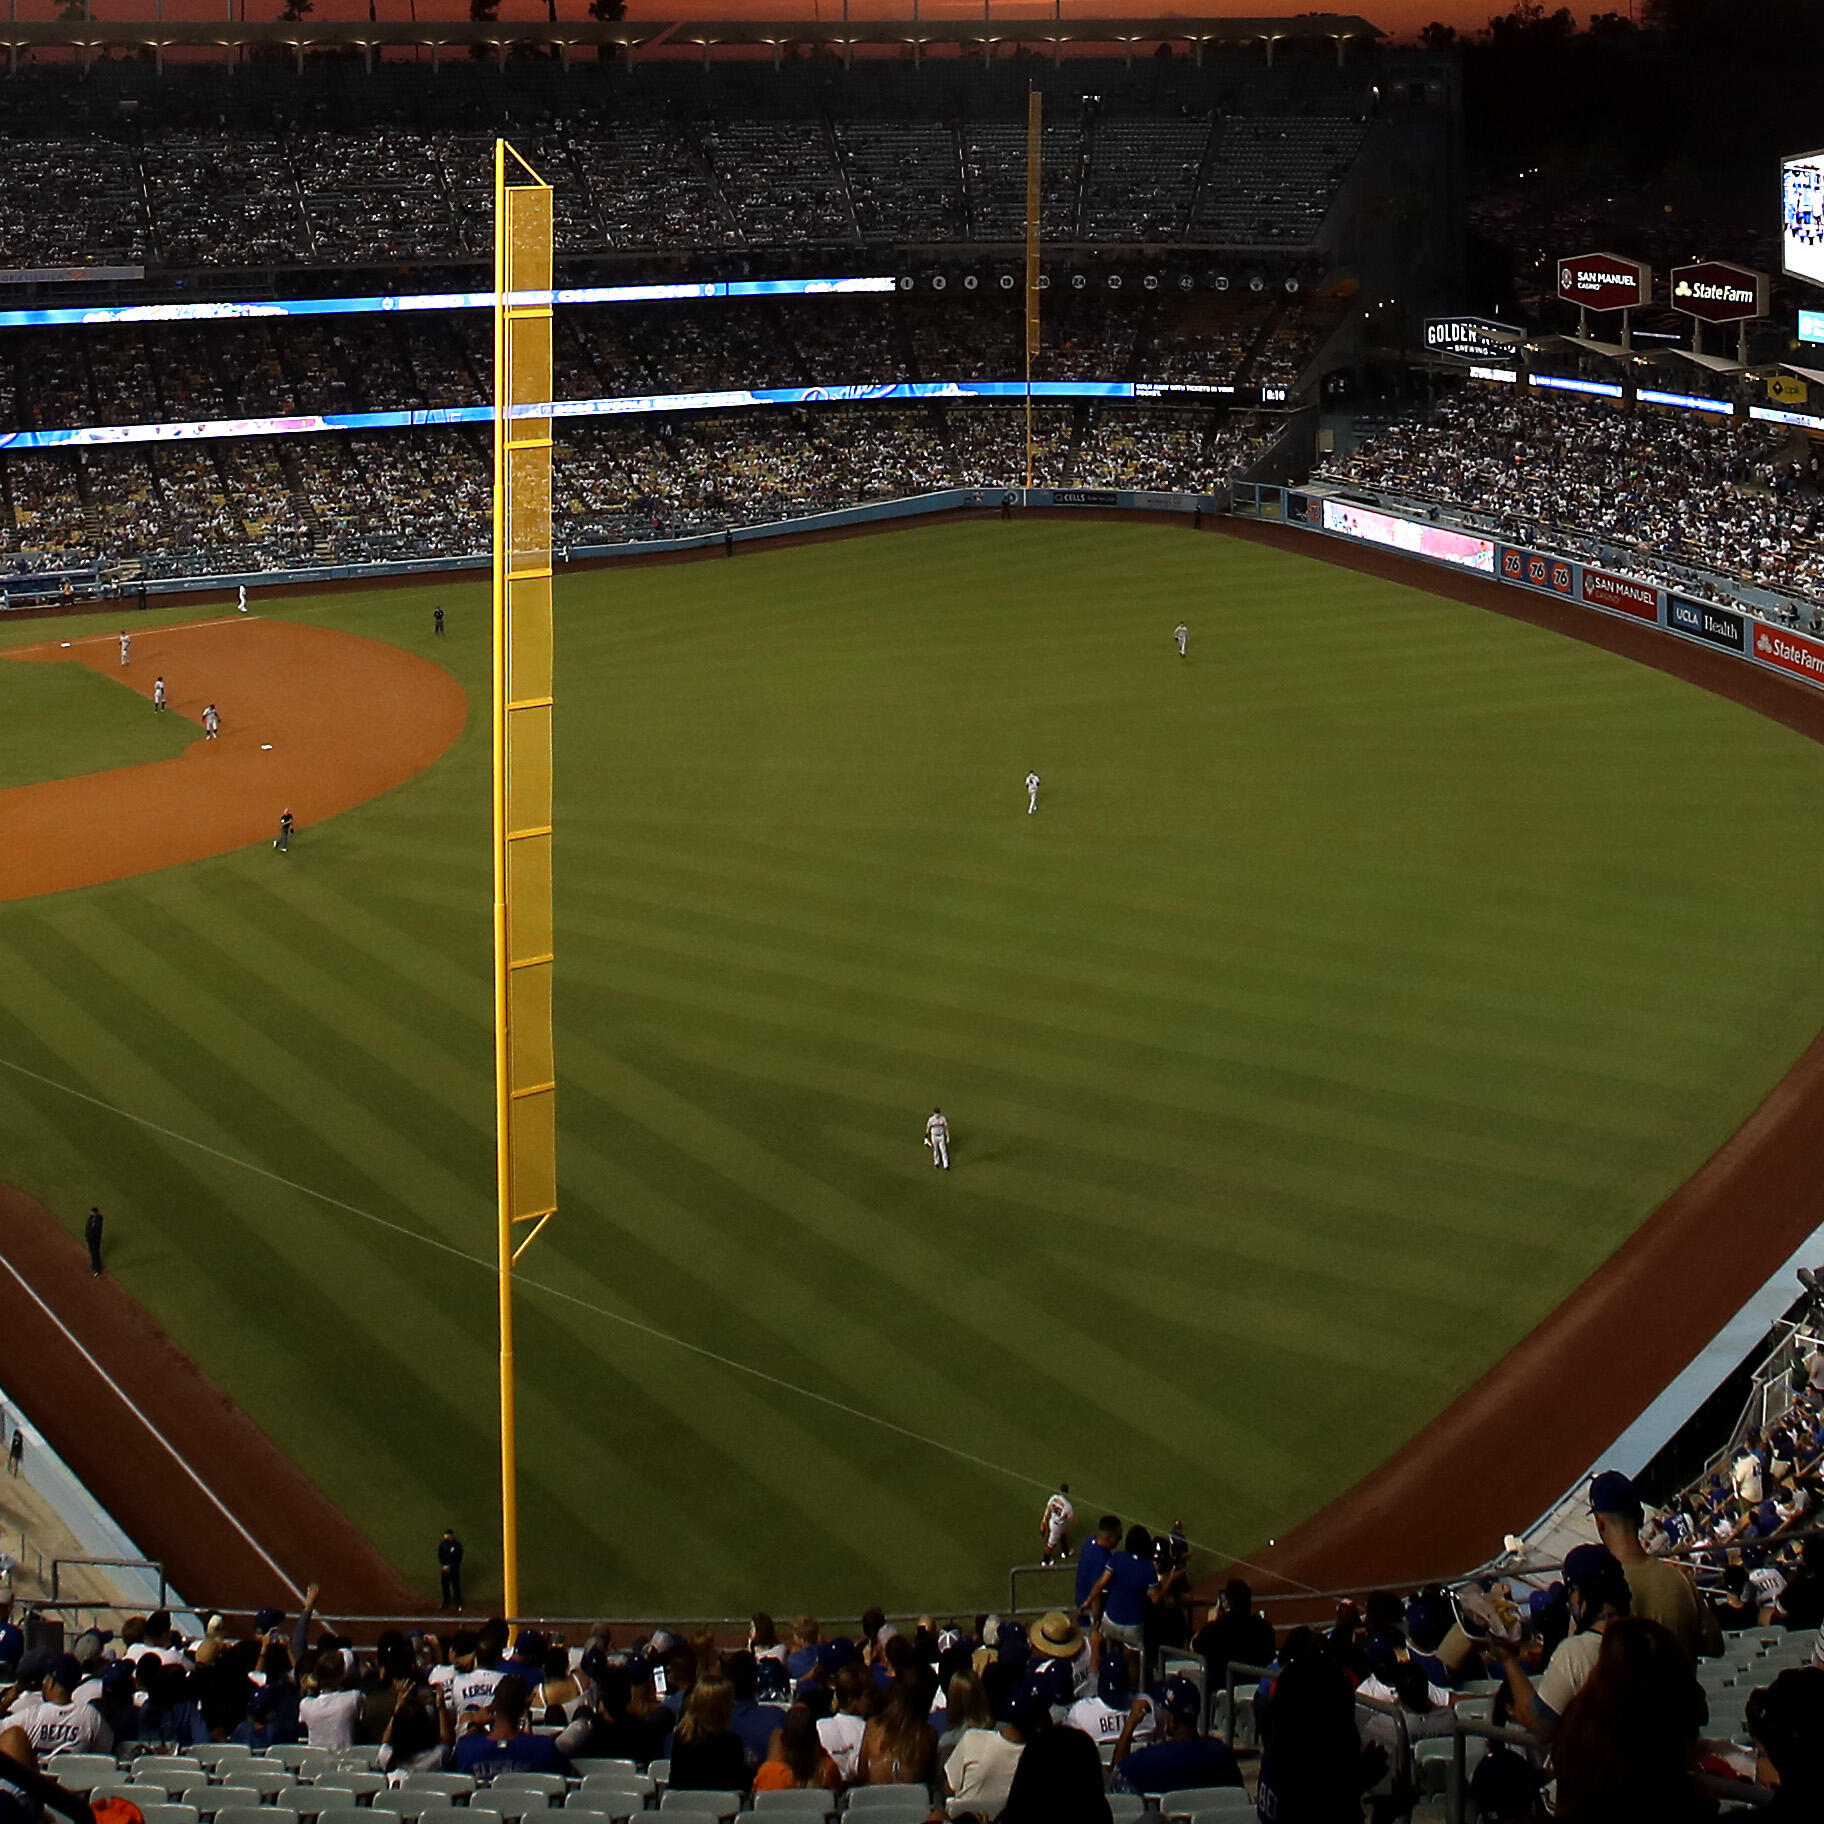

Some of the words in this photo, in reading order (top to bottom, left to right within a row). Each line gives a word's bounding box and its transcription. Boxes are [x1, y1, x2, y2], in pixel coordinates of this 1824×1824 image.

[1577, 271, 1596, 283] SAN
[1597, 273, 1637, 287] MANUEL
[1428, 323, 1477, 345] GOLDEN
[1505, 554, 1520, 572] 76
[1530, 562, 1545, 579] 76
[1554, 570, 1568, 586] 76
[1594, 577, 1615, 594] SAN
[1616, 583, 1655, 607] MANUEL
[1676, 607, 1699, 626] UCLA
[1704, 614, 1738, 640] Health
[40, 1724, 80, 1741] BETTS
